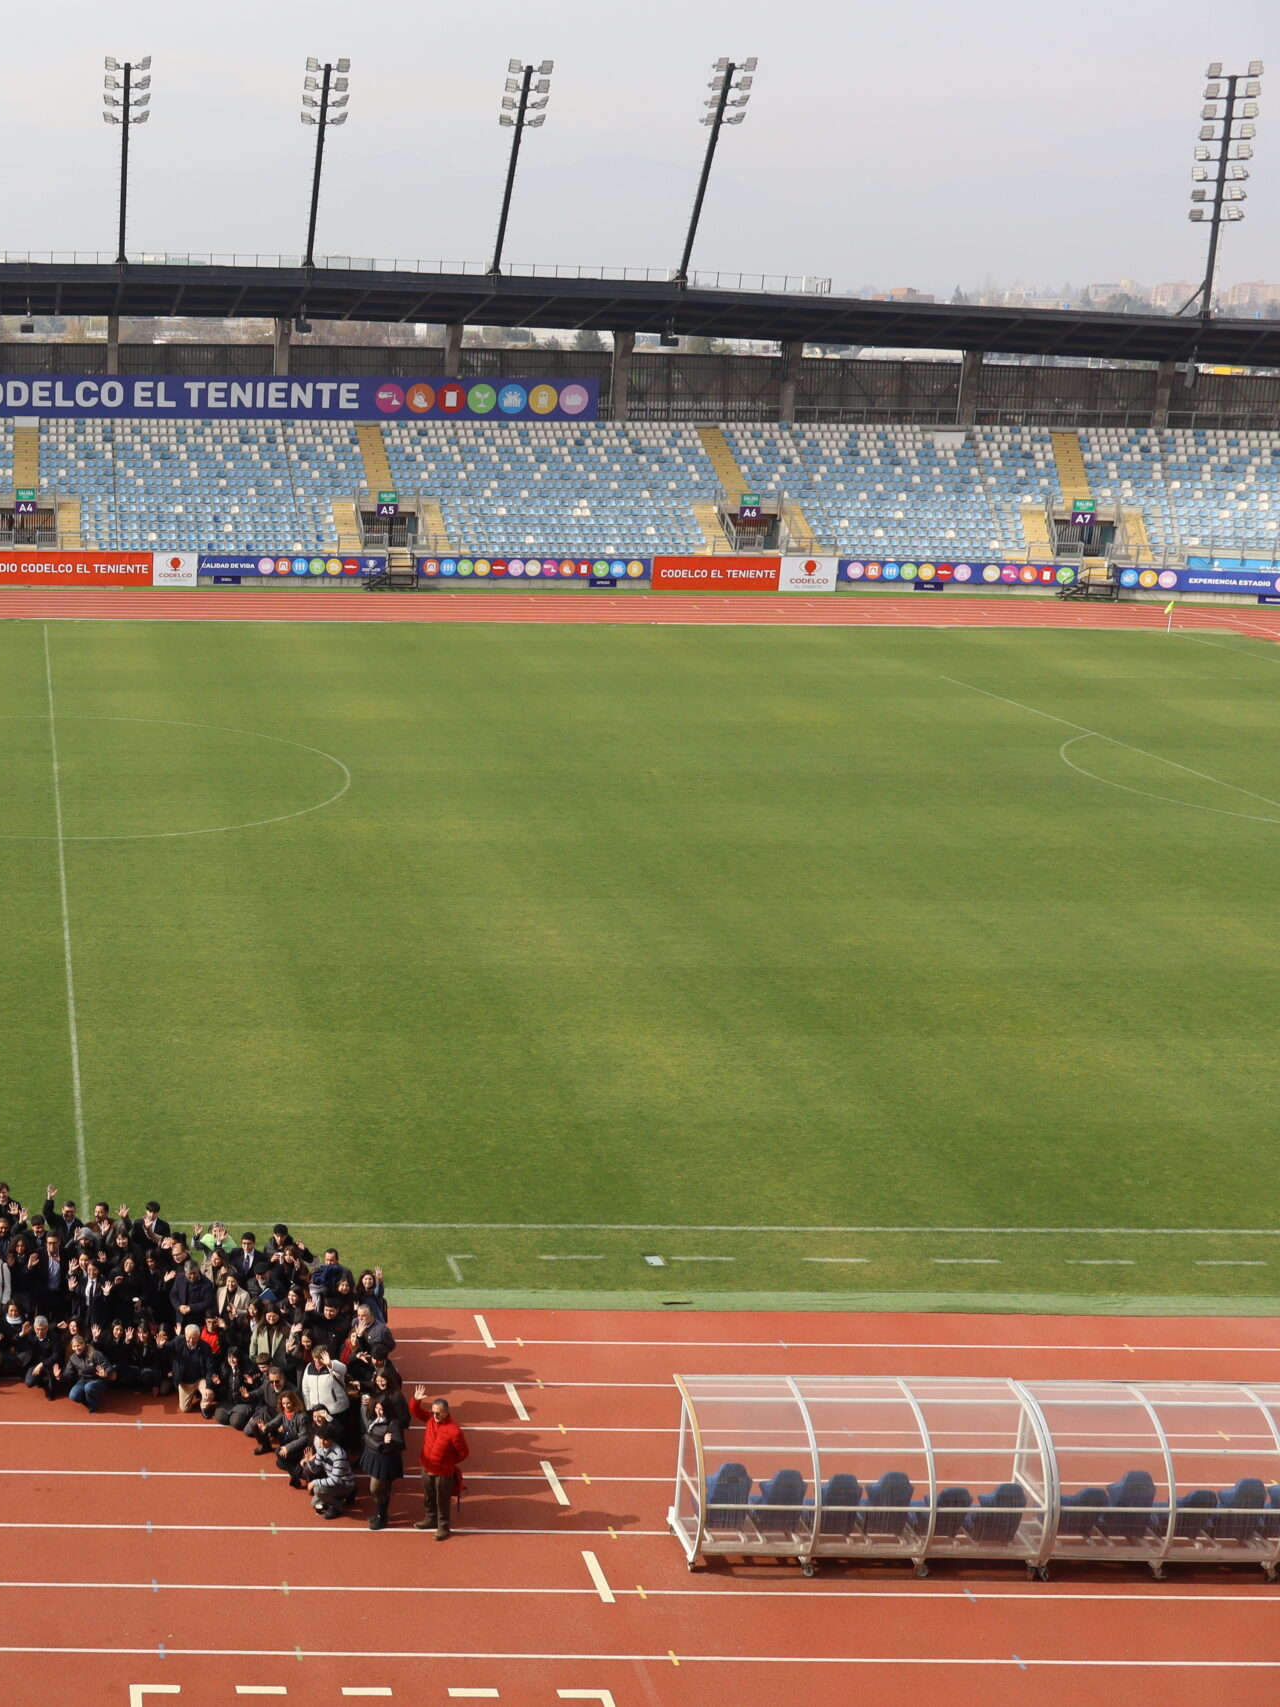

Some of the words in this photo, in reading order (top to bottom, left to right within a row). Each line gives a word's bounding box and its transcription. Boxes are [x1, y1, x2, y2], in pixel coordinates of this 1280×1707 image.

[134, 381, 176, 407] EL
[184, 382, 360, 409] TENIENTE
[19, 503, 33, 512] A4
[380, 506, 395, 514] A5
[743, 509, 757, 517] A6
[1075, 514, 1091, 523] A7
[20, 563, 73, 573] CODELCO
[77, 563, 90, 573] EL
[93, 564, 149, 574] TENIENTE
[660, 569, 708, 578] CODELCO
[710, 569, 723, 578] EL
[726, 569, 776, 578] TENIENTE
[1188, 577, 1237, 585] EXPERIENCIA
[1238, 579, 1271, 587] ESTADIO
